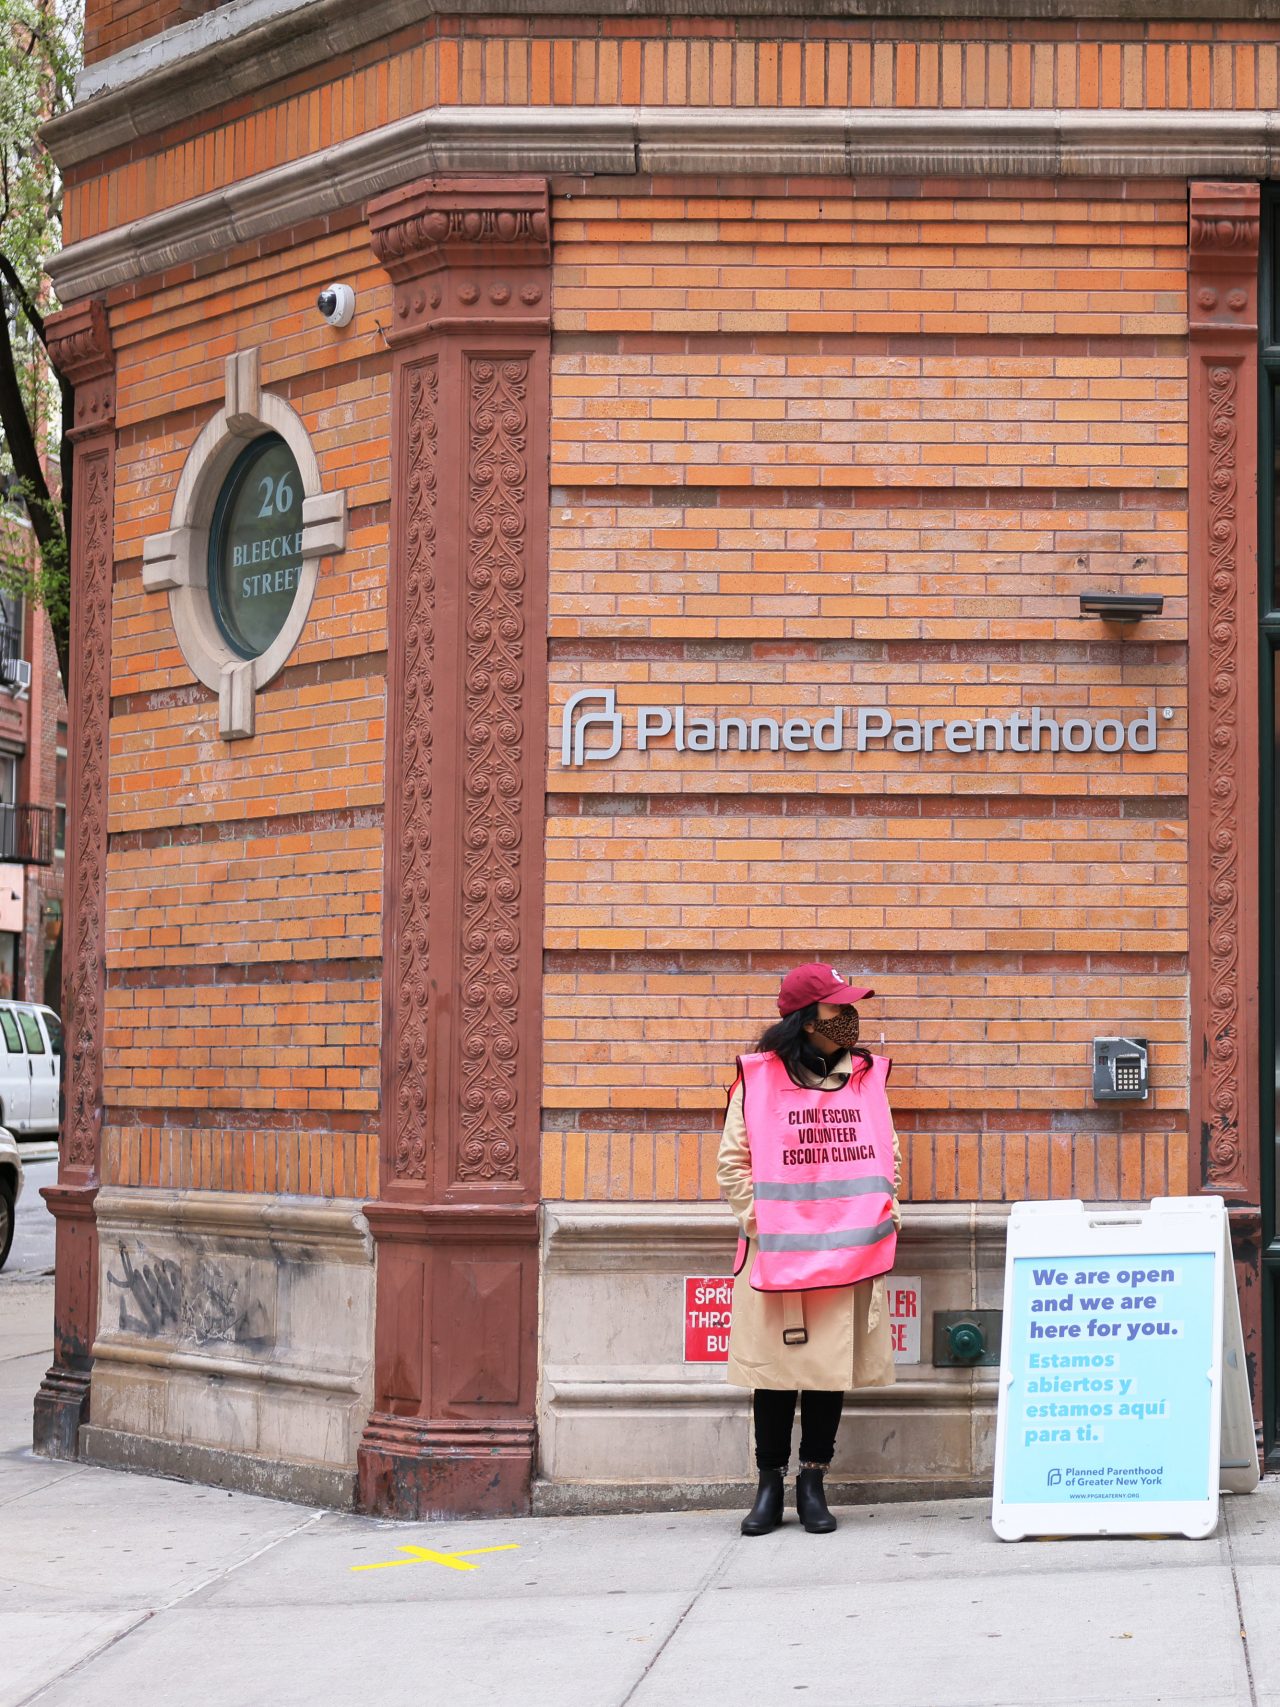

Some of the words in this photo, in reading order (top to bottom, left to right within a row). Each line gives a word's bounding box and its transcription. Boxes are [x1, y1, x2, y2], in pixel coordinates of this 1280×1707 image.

[257, 470, 294, 519] 26
[242, 567, 303, 598] STREET
[637, 705, 842, 752] Planned
[788, 1108, 820, 1125] CLINI
[822, 1108, 861, 1124] ESCORT
[798, 1127, 857, 1145] VOLUNTEER
[783, 1147, 829, 1166] ESCOLTA
[831, 1144, 876, 1163] CLINICA
[1032, 1269, 1069, 1286] We
[1074, 1270, 1110, 1285] are
[1116, 1268, 1175, 1288] open
[1030, 1293, 1074, 1312] and
[1079, 1297, 1115, 1311] we
[1120, 1295, 1157, 1310] are
[689, 1311, 732, 1328] THRO
[1030, 1320, 1082, 1339] here
[1087, 1318, 1121, 1337] for
[1126, 1321, 1178, 1341] you.
[1028, 1353, 1115, 1369] Estamos
[1027, 1376, 1114, 1393] abiertos
[1118, 1378, 1132, 1395] y
[1026, 1402, 1113, 1418] estamos
[1118, 1398, 1167, 1420] aquí
[1025, 1429, 1071, 1447] para
[1076, 1424, 1099, 1441] ti.
[1065, 1467, 1105, 1476] Planned
[1107, 1466, 1163, 1476] Parenthood
[1065, 1478, 1076, 1487] of
[1077, 1478, 1114, 1486] Greater
[1116, 1478, 1138, 1486] New
[1140, 1476, 1162, 1486] York
